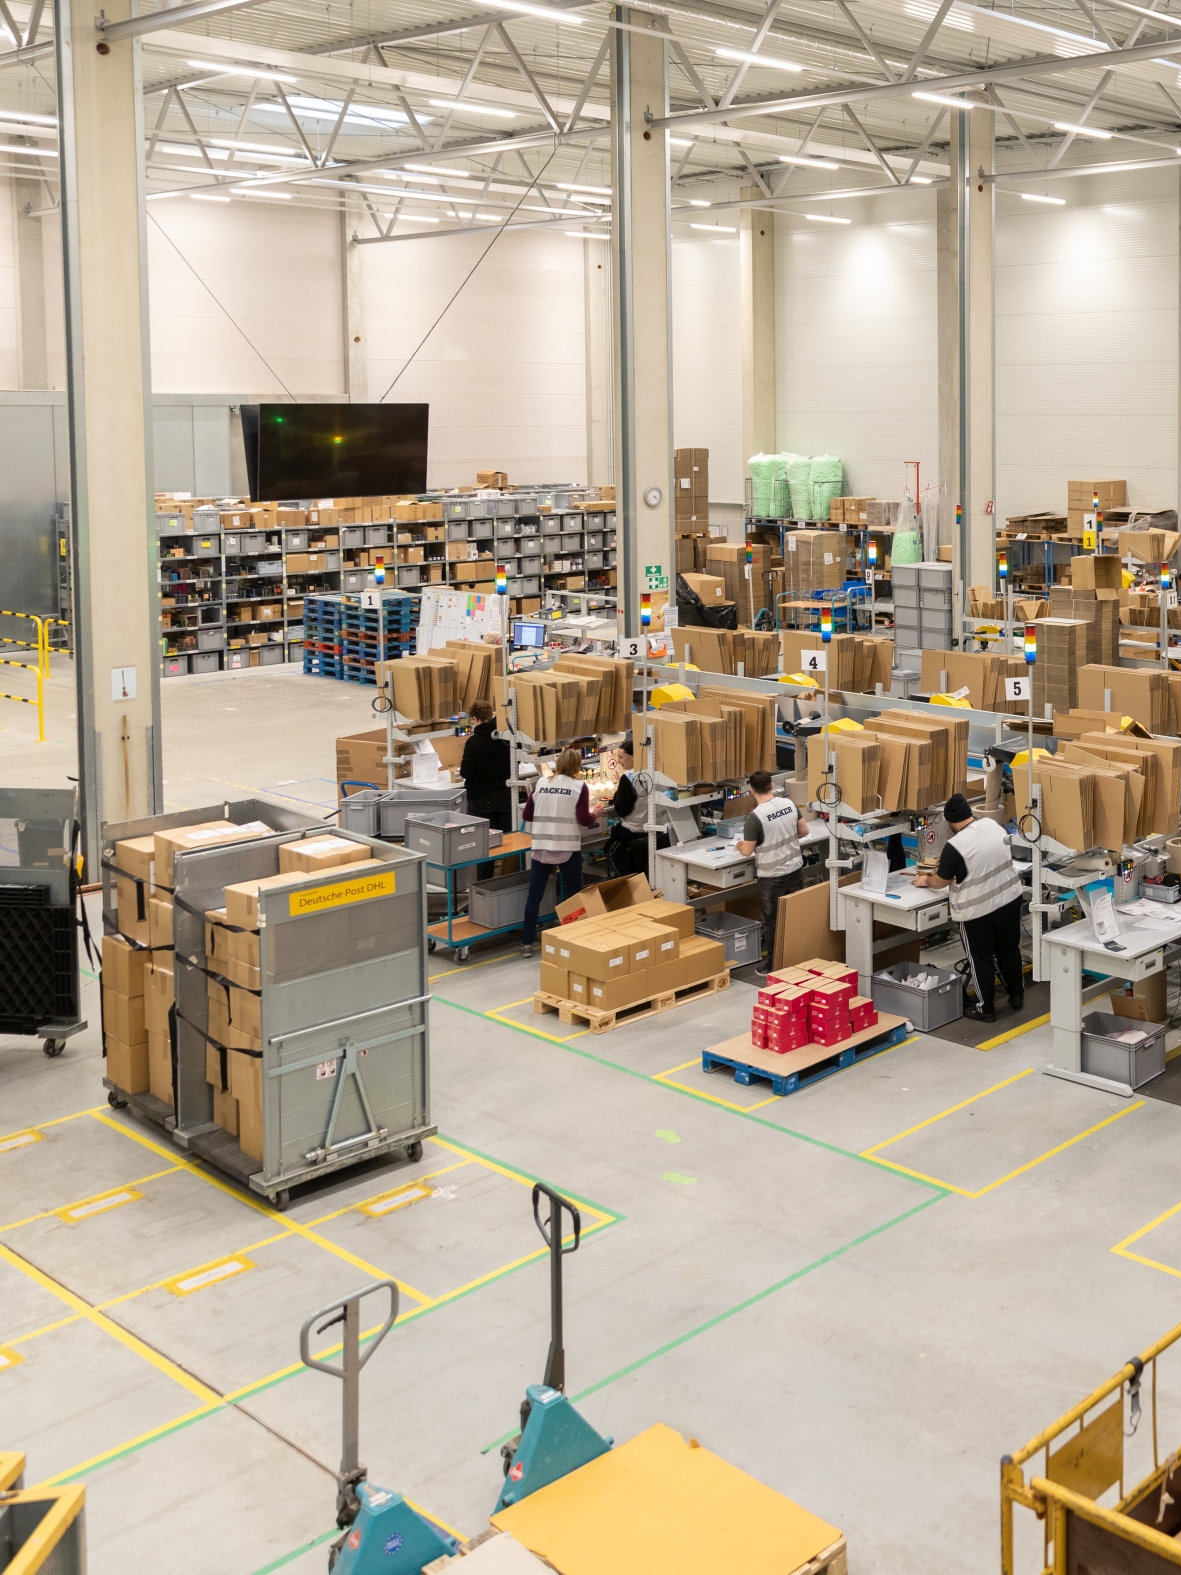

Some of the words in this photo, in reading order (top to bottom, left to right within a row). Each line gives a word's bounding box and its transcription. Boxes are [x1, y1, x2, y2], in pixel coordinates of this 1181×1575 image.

[1087, 520, 1092, 529] 1
[1086, 537, 1092, 546] 1
[867, 572, 870, 580] 9
[368, 595, 373, 605] 1
[630, 644, 637, 655] 3
[809, 656, 818, 669] 4
[1014, 682, 1021, 696] 5
[767, 806, 793, 821] PACKER
[300, 892, 343, 907] Deutsche
[346, 887, 364, 896] Post
[367, 881, 386, 892] DHL
